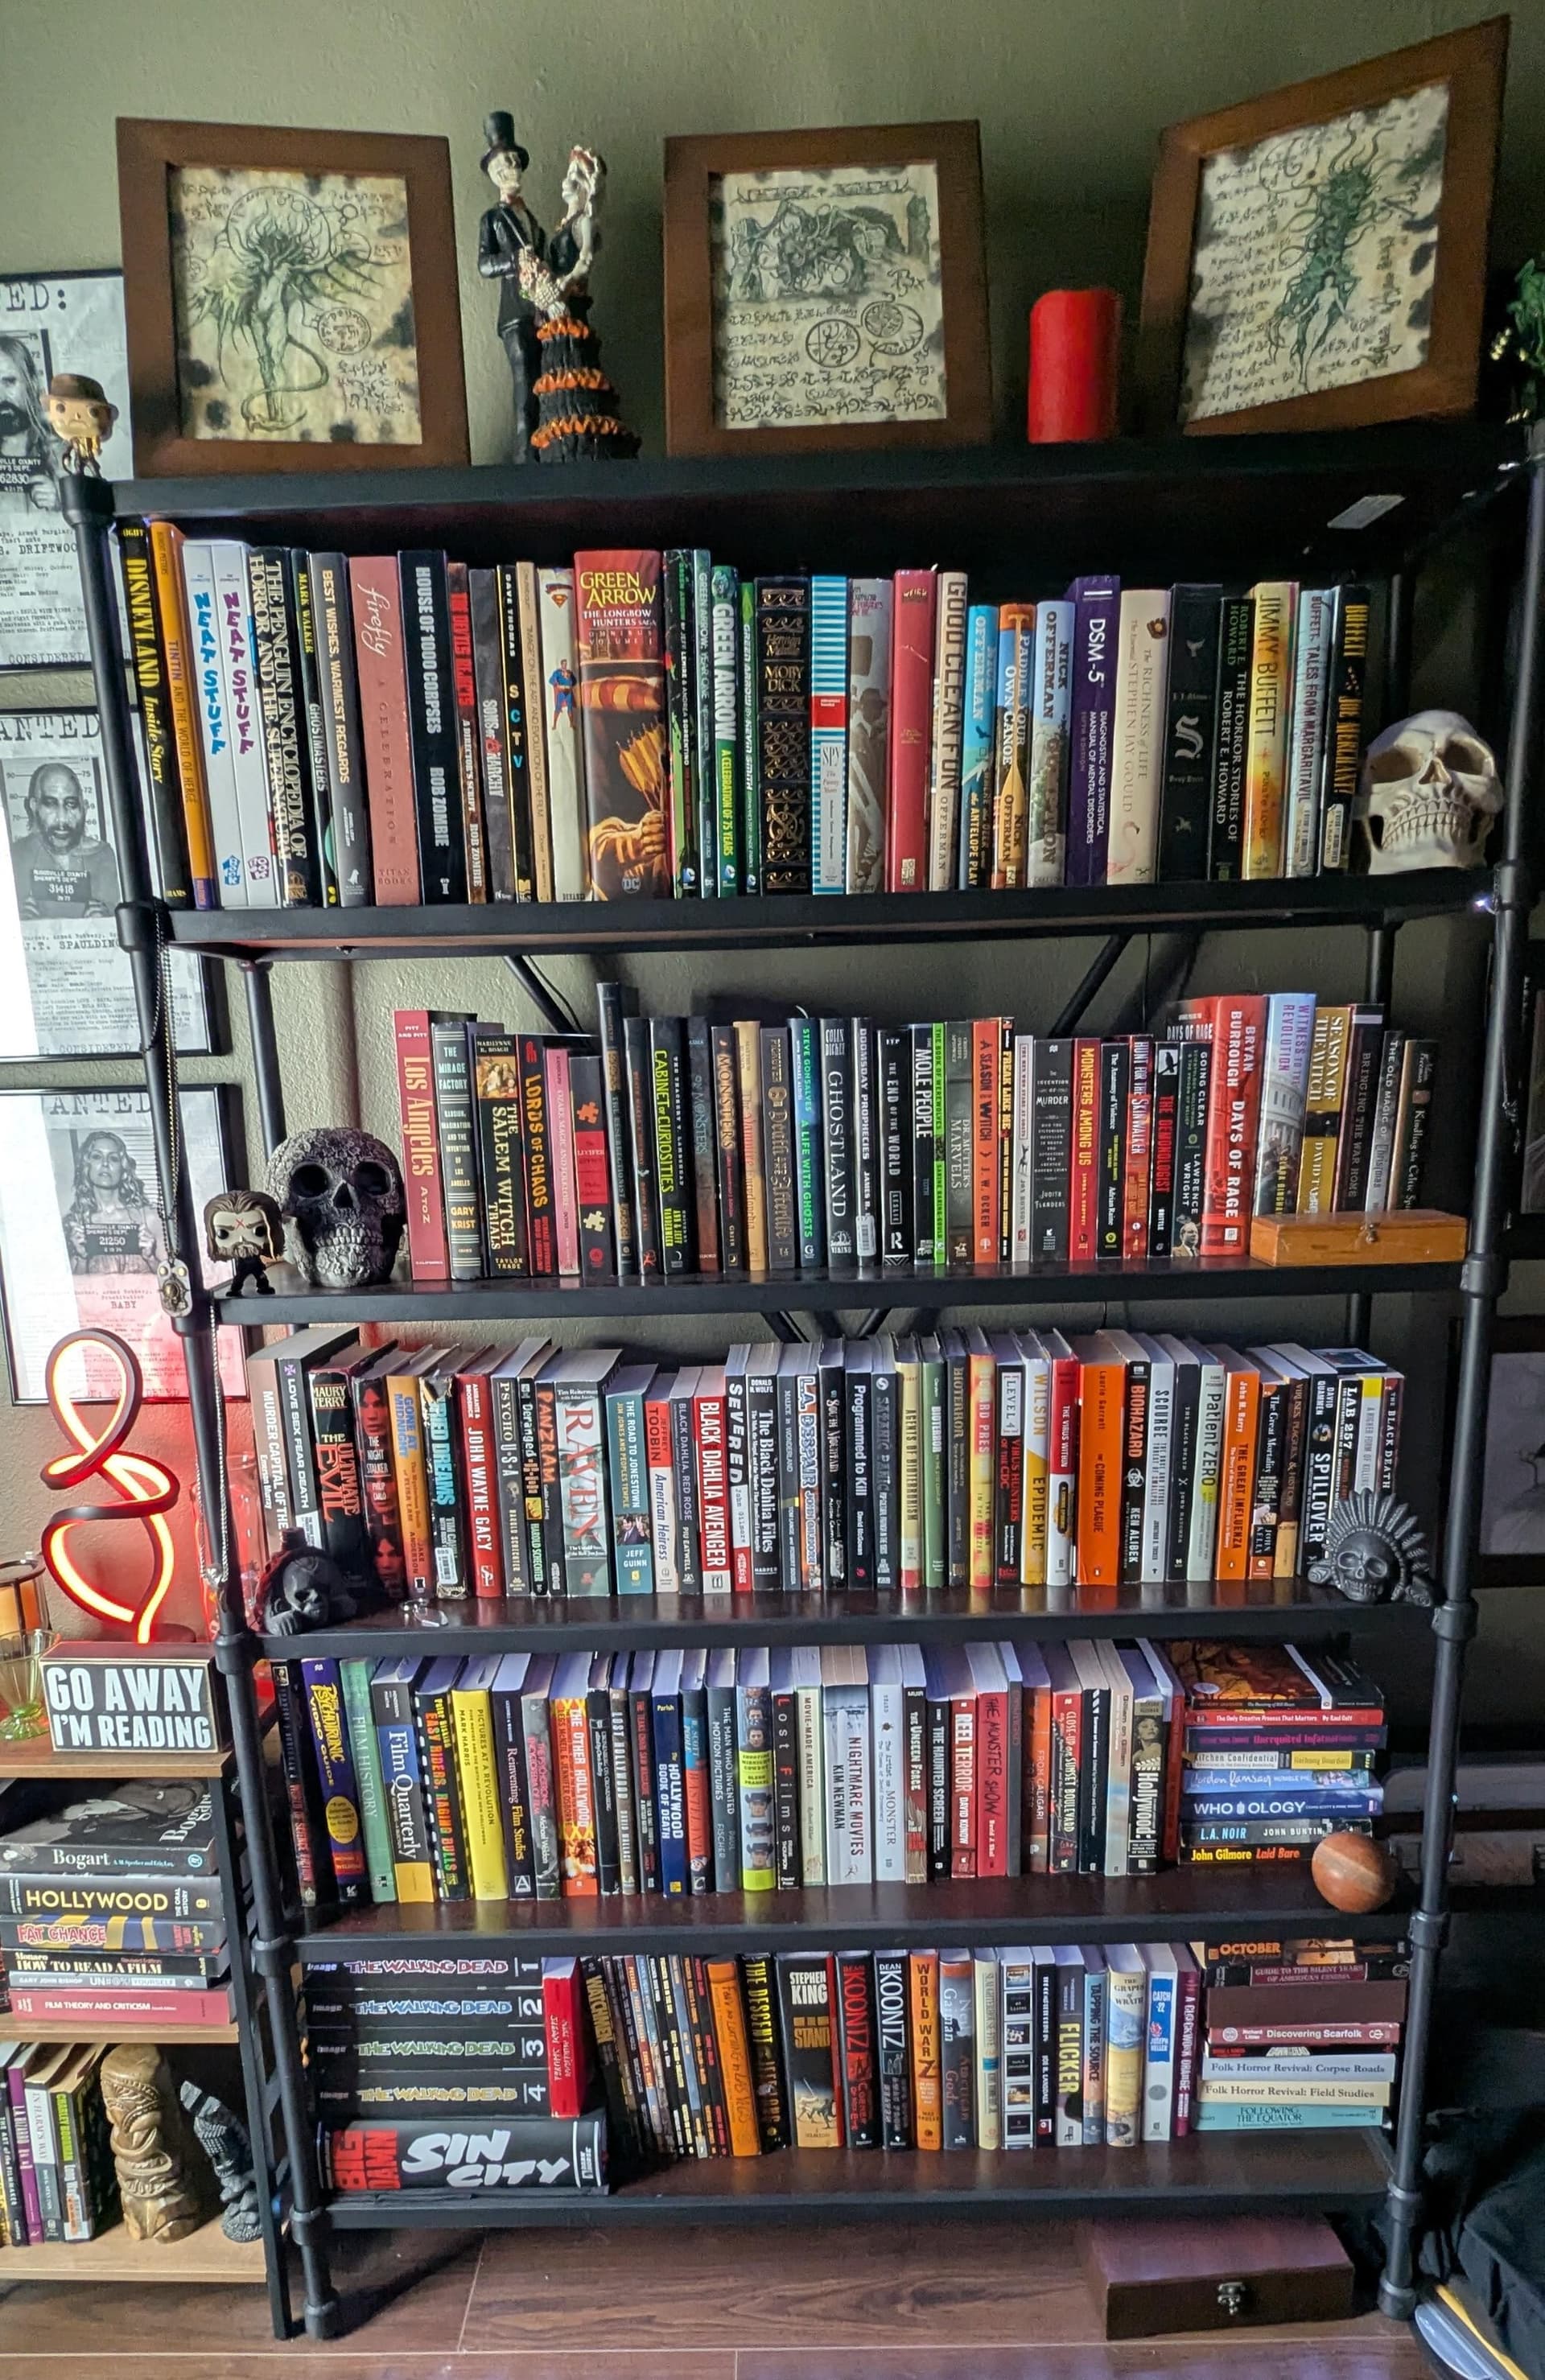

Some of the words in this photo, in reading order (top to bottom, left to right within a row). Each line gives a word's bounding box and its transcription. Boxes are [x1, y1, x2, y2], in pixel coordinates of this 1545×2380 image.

[19, 543, 77, 554] DRIFTWOO
[266, 561, 286, 604] THE
[321, 570, 336, 601] BEST
[415, 566, 434, 611] HOUSE
[580, 571, 641, 589] GREEN
[587, 585, 657, 608] ARROW
[126, 558, 160, 687] DISNEYLAND
[193, 592, 216, 663] NEAT
[223, 592, 245, 663] NEAT
[324, 605, 340, 653] WISHES,
[358, 585, 392, 657] firefly
[418, 613, 435, 631] OF
[583, 610, 602, 619] THE
[604, 609, 652, 619] LONGBOW
[592, 618, 636, 627] HUNTERS
[945, 581, 966, 646] GOOD
[1258, 595, 1282, 653] JIMMY
[270, 607, 293, 694] PENGUIN
[420, 632, 437, 667] 1000
[712, 603, 735, 665] GREEN
[1088, 618, 1106, 684] DSM-5
[764, 665, 804, 680] MOBY
[1042, 611, 1058, 719] OFFERMAN
[1057, 641, 1069, 690] NICK
[329, 657, 344, 717] WARMEST
[422, 669, 442, 733] CORPSES
[768, 677, 801, 694] DICK
[941, 655, 963, 736] CLEAN
[1255, 662, 1279, 736] BUFFETT
[143, 696, 160, 741] Inside
[204, 670, 226, 755] STUFF
[233, 670, 253, 755] STUFF
[714, 669, 737, 741] ARROW
[0, 715, 101, 740] ANTED
[147, 743, 163, 783] Story
[277, 698, 304, 831] ENCYCLOPEDIA
[334, 722, 350, 782] REGARDS
[939, 744, 961, 790] FUN
[430, 768, 446, 795] ROB
[431, 797, 448, 846] ZOMBIE
[288, 833, 307, 859] OF
[60, 940, 120, 950] SPAULDIN
[444, 1047, 457, 1057] THE
[1227, 1010, 1242, 1086] BURROUGH
[1243, 1026, 1255, 1070] BRYAN
[404, 1056, 431, 1090] Los
[439, 1062, 466, 1073] MIRAGE
[439, 1079, 468, 1090] FACTORY
[915, 1049, 930, 1089] MOLE
[1080, 1048, 1095, 1103] MONSTERS
[1198, 1052, 1207, 1087] GOING
[49, 1093, 151, 1115] ANTED
[506, 1104, 520, 1134] THE
[525, 1075, 544, 1134] LORDS
[916, 1094, 933, 1139] PEOPLE
[1197, 1091, 1206, 1126] CLEAR
[1230, 1101, 1246, 1142] DAYS
[403, 1096, 437, 1176] Angeles
[492, 1106, 511, 1172] SALEM
[800, 1119, 809, 1127] A
[1079, 1109, 1094, 1147] AMONG
[531, 1137, 543, 1152] OF
[801, 1131, 810, 1155] LIFE
[827, 1070, 847, 1216] GHOSTLAND
[1078, 1151, 1093, 1165] US
[1228, 1149, 1242, 1168] OF
[532, 1155, 548, 1209] CHAOS
[801, 1159, 811, 1189] WITH
[1182, 1162, 1192, 1206] WRIGHT
[1191, 1153, 1201, 1213] LAWRENCE
[451, 1206, 475, 1217] GARY
[496, 1179, 516, 1246] WITCH
[803, 1192, 813, 1237] GHOSTS
[1225, 1176, 1241, 1217] RAGE
[451, 1220, 476, 1229] KRIST
[490, 1201, 501, 1250] TRIALS
[287, 1378, 299, 1408] LOVE
[625, 1400, 635, 1414] THE
[1345, 1386, 1358, 1413] LAB
[290, 1412, 302, 1435] SEX
[626, 1417, 637, 1438] ROAD
[699, 1402, 721, 1443] BLACK
[728, 1382, 743, 1482] SEVERED
[759, 1409, 773, 1435] The
[851, 1385, 867, 1457] Programmed
[1128, 1385, 1145, 1457] BIOHAZARD
[1153, 1390, 1169, 1437] SCOURGE
[1204, 1393, 1222, 1445] Patient
[468, 1427, 485, 1464] JOHN
[628, 1441, 637, 1451] TO
[1344, 1419, 1354, 1448] 257
[294, 1438, 305, 1467] FEAR
[760, 1438, 775, 1473] Black
[853, 1460, 867, 1472] to
[1201, 1450, 1218, 1485] ZERO
[297, 1471, 308, 1507] DEATH
[628, 1454, 640, 1507] JONESTOWN
[702, 1449, 723, 1497] DAHLIA
[854, 1476, 867, 1495] Kill
[471, 1470, 490, 1514] WAYNE
[655, 1473, 667, 1518] American
[761, 1477, 776, 1518] Dahlia
[1308, 1453, 1330, 1542] SPILLOVER
[1032, 1476, 1045, 1550] EPIDEMIC
[1130, 1507, 1140, 1526] KEN
[474, 1520, 492, 1550] GACY
[657, 1523, 668, 1559] Heiress
[704, 1504, 726, 1566] AVENGER
[762, 1521, 777, 1552] Files
[1129, 1529, 1139, 1562] ALIBEK
[46, 1668, 94, 1711] GO
[105, 1669, 204, 1712] AWAY
[97, 1715, 211, 1748] READING
[389, 1731, 411, 1777] Film
[848, 1736, 863, 1805] NIGHTMARE
[659, 1763, 669, 1789] BOOK
[833, 1764, 844, 1782] KIM
[660, 1792, 669, 1804] OF
[669, 1763, 683, 1839] HOLLYWOOD
[834, 1786, 846, 1830] NEWMAN
[1194, 1802, 1233, 1814] WHO
[1248, 1801, 1306, 1814] OLOGY
[393, 1779, 421, 1859] Quarterly
[661, 1807, 670, 1838] DEATH
[851, 1810, 863, 1855] MOVIES
[1201, 1829, 1219, 1840] L.A.
[1222, 1828, 1246, 1839] NOIR
[1263, 1827, 1286, 1836] JOHN
[1291, 1827, 1322, 1835] BUNTIN
[53, 1849, 110, 1868] Bogart
[1191, 1849, 1213, 1861] John
[1216, 1848, 1252, 1860] Gilmore
[26, 1890, 168, 1911] HOLLYWOOD
[17, 1925, 43, 1942] FAT
[47, 1925, 107, 1943] CHANCE
[1220, 1943, 1280, 1954] OCTOBER
[344, 1961, 381, 1973] THE
[381, 1960, 457, 1973] WALKING
[458, 1960, 509, 1973] DEAD
[789, 1971, 826, 1984] STEPHEN
[45, 2001, 62, 2009] FILM
[113, 2002, 150, 2010] CRITICISM
[792, 1984, 828, 2005] KING
[845, 1970, 869, 2049] KOONTZ
[880, 1970, 904, 2049] KOONTZ
[917, 1963, 930, 2020] WORLD
[919, 2024, 932, 2057] WAR
[1267, 2029, 1321, 2039] Discovering
[1324, 2029, 1362, 2037] Scarfolk
[918, 2060, 937, 2079] Z
[1058, 2022, 1080, 2093] FLICKER
[1316, 2065, 1350, 2073] Corpse
[1354, 2065, 1385, 2073] Roads
[402, 2130, 511, 2173] SIN
[447, 2157, 570, 2188] CITY
